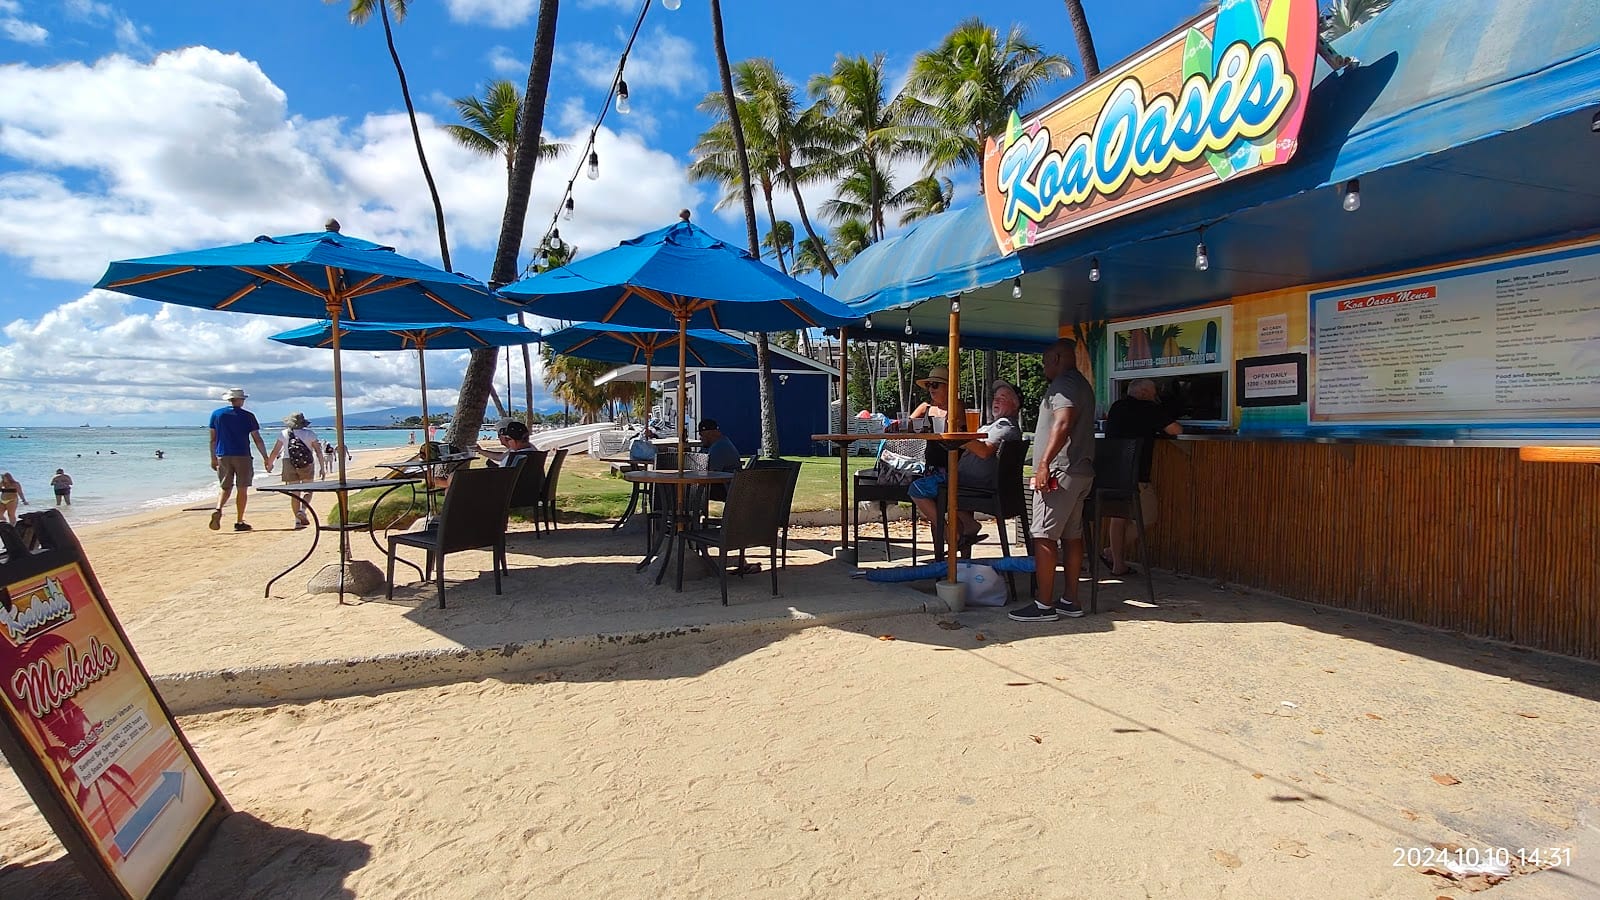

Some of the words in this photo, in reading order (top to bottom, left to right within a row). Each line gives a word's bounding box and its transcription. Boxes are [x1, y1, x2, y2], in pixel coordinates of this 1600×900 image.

[1343, 300, 1364, 310] Koa
[1366, 296, 1394, 308] Oasis
[1396, 288, 1430, 303] Menu
[12, 636, 117, 717] Mahalo
[102, 740, 112, 752] Open
[132, 716, 143, 726] hours
[108, 748, 119, 758] Open
[138, 722, 149, 731] hours
